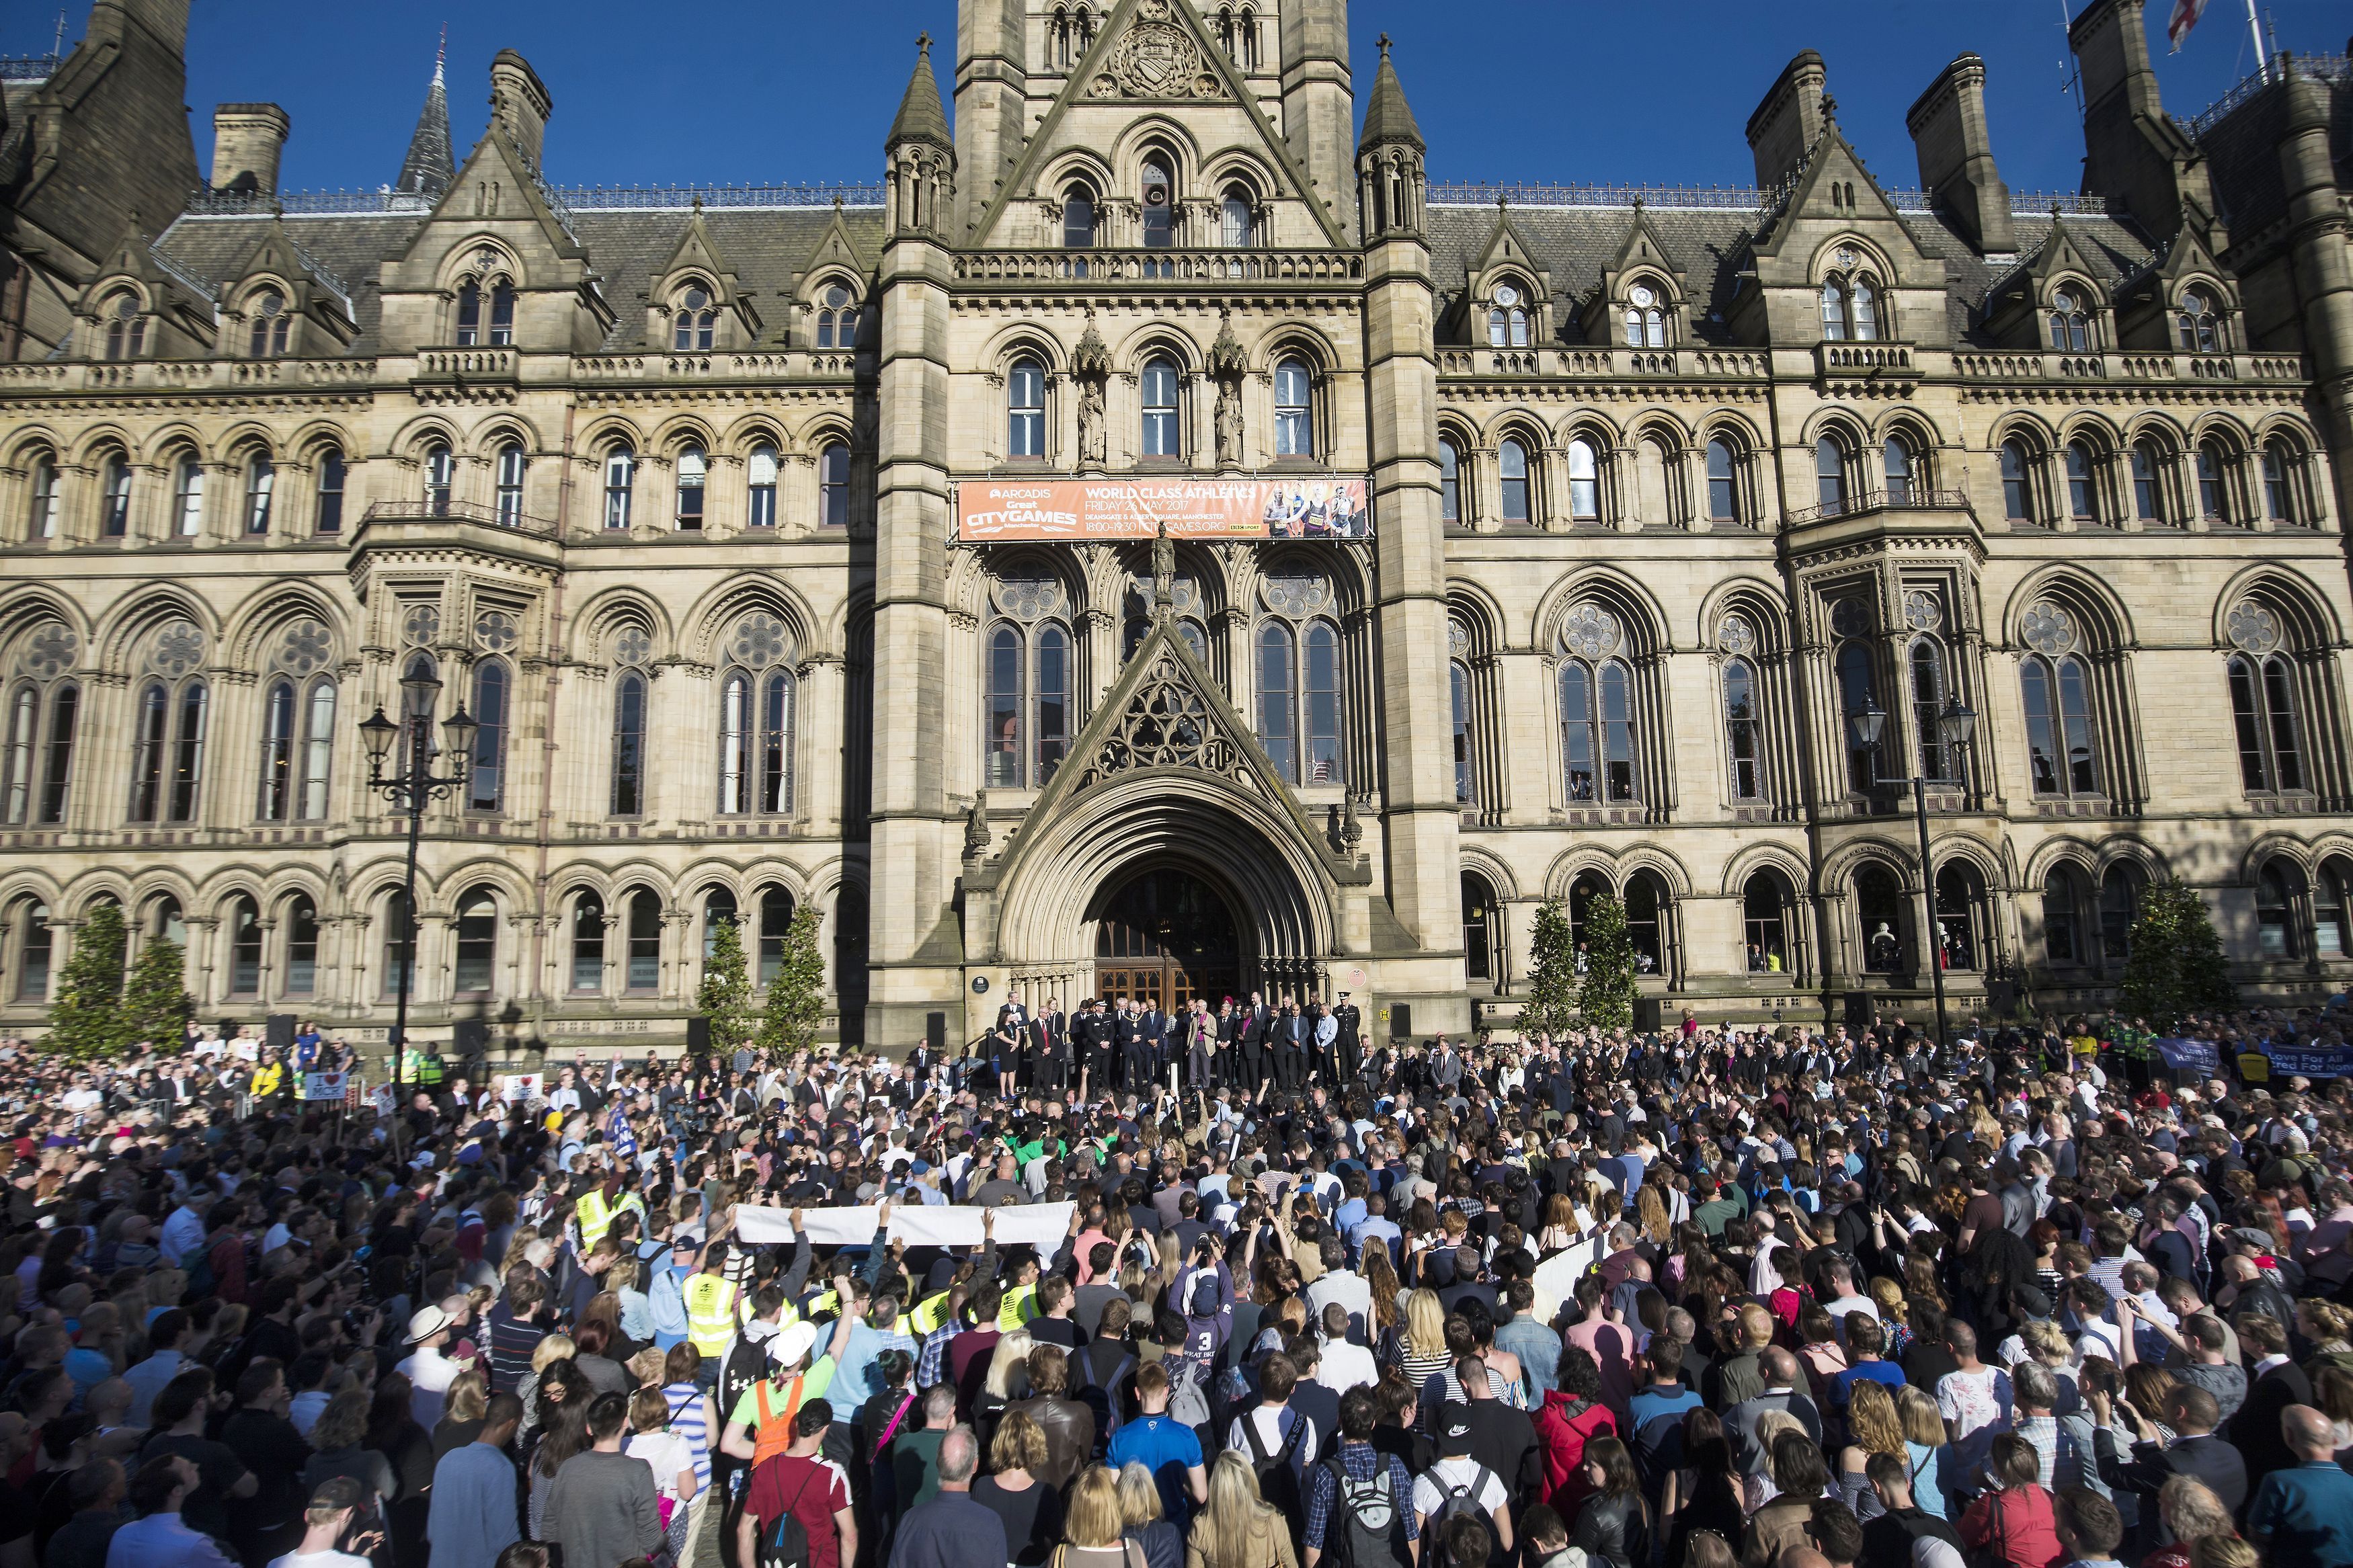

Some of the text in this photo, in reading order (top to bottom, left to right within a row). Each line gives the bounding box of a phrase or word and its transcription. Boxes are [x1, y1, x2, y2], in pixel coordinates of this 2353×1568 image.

[1002, 489, 1051, 499] ARCADIS
[1085, 487, 1256, 499] WORLD CLASS ATHLETICS
[1006, 501, 1038, 509] Great
[1085, 500, 1189, 511] FRIDAY 26 MAY 2017
[967, 510, 1077, 527] CITYGAMES
[1086, 522, 1226, 532] 18:00-19:30 CITGAMES.ORG
[2184, 1046, 2203, 1056] Love
[2176, 1054, 2204, 1064] Hatred
[2268, 1052, 2344, 1063] Love For All
[2271, 1060, 2297, 1070] tred
[2301, 1063, 2324, 1071] For
[315, 1075, 323, 1086] I
[512, 1078, 519, 1087] I
[312, 1086, 341, 1096] MCR
[511, 1087, 533, 1096] MCR
[1199, 1331, 1211, 1351] 3
[1452, 1424, 1466, 1433] NIKE
